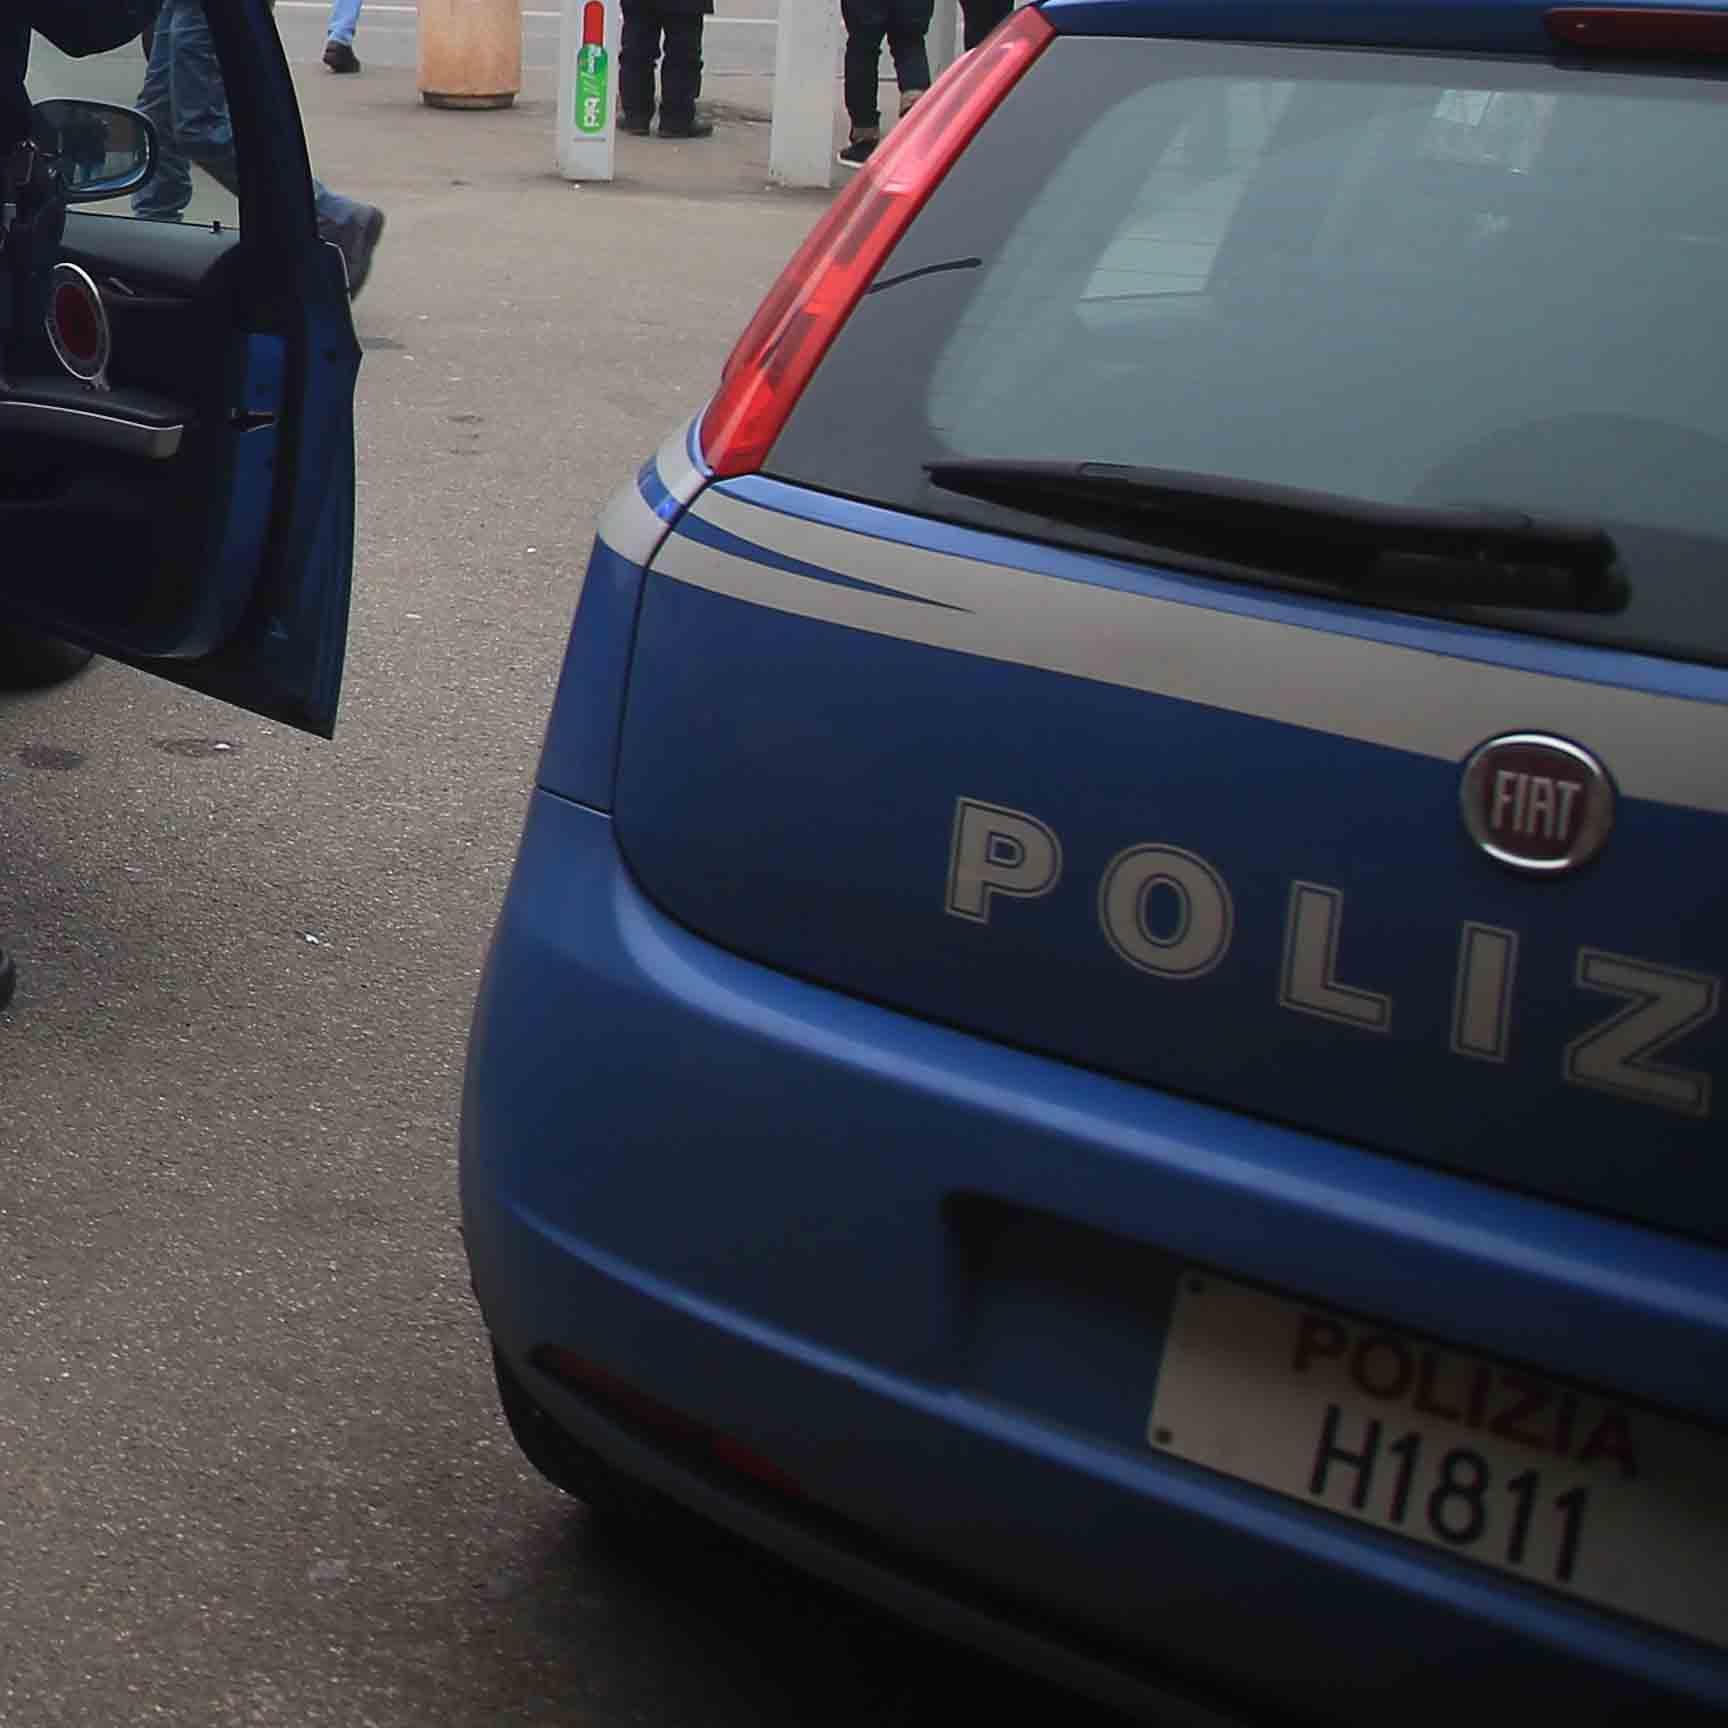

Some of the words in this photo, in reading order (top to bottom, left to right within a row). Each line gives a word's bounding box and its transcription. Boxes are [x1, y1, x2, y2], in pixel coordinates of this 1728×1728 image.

[1490, 768, 1583, 841] FIAT
[945, 794, 1722, 1119] POLIZ
[1292, 1311, 1639, 1480] POLIZIA
[1308, 1403, 1590, 1584] H1811
